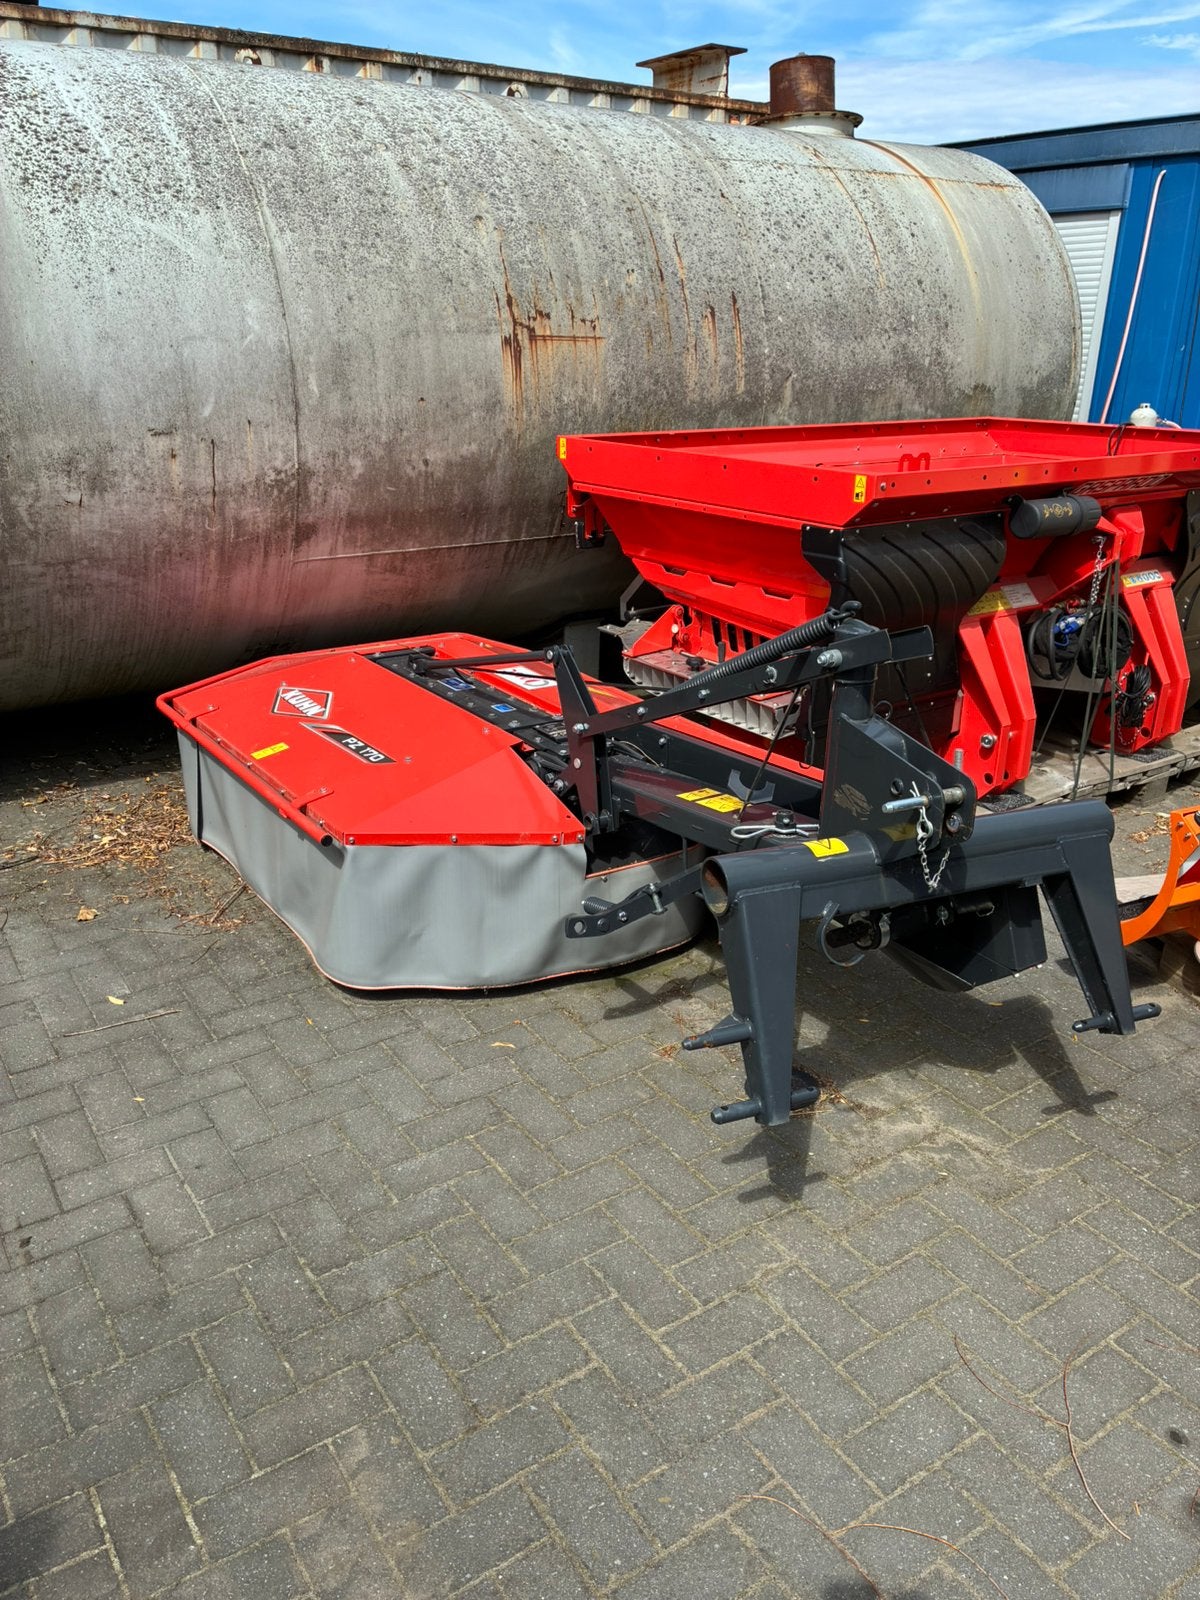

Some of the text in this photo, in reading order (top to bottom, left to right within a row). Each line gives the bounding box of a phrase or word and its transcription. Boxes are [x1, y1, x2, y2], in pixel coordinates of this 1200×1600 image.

[280, 689, 325, 717] KUHN
[341, 737, 385, 762] PZ 170
